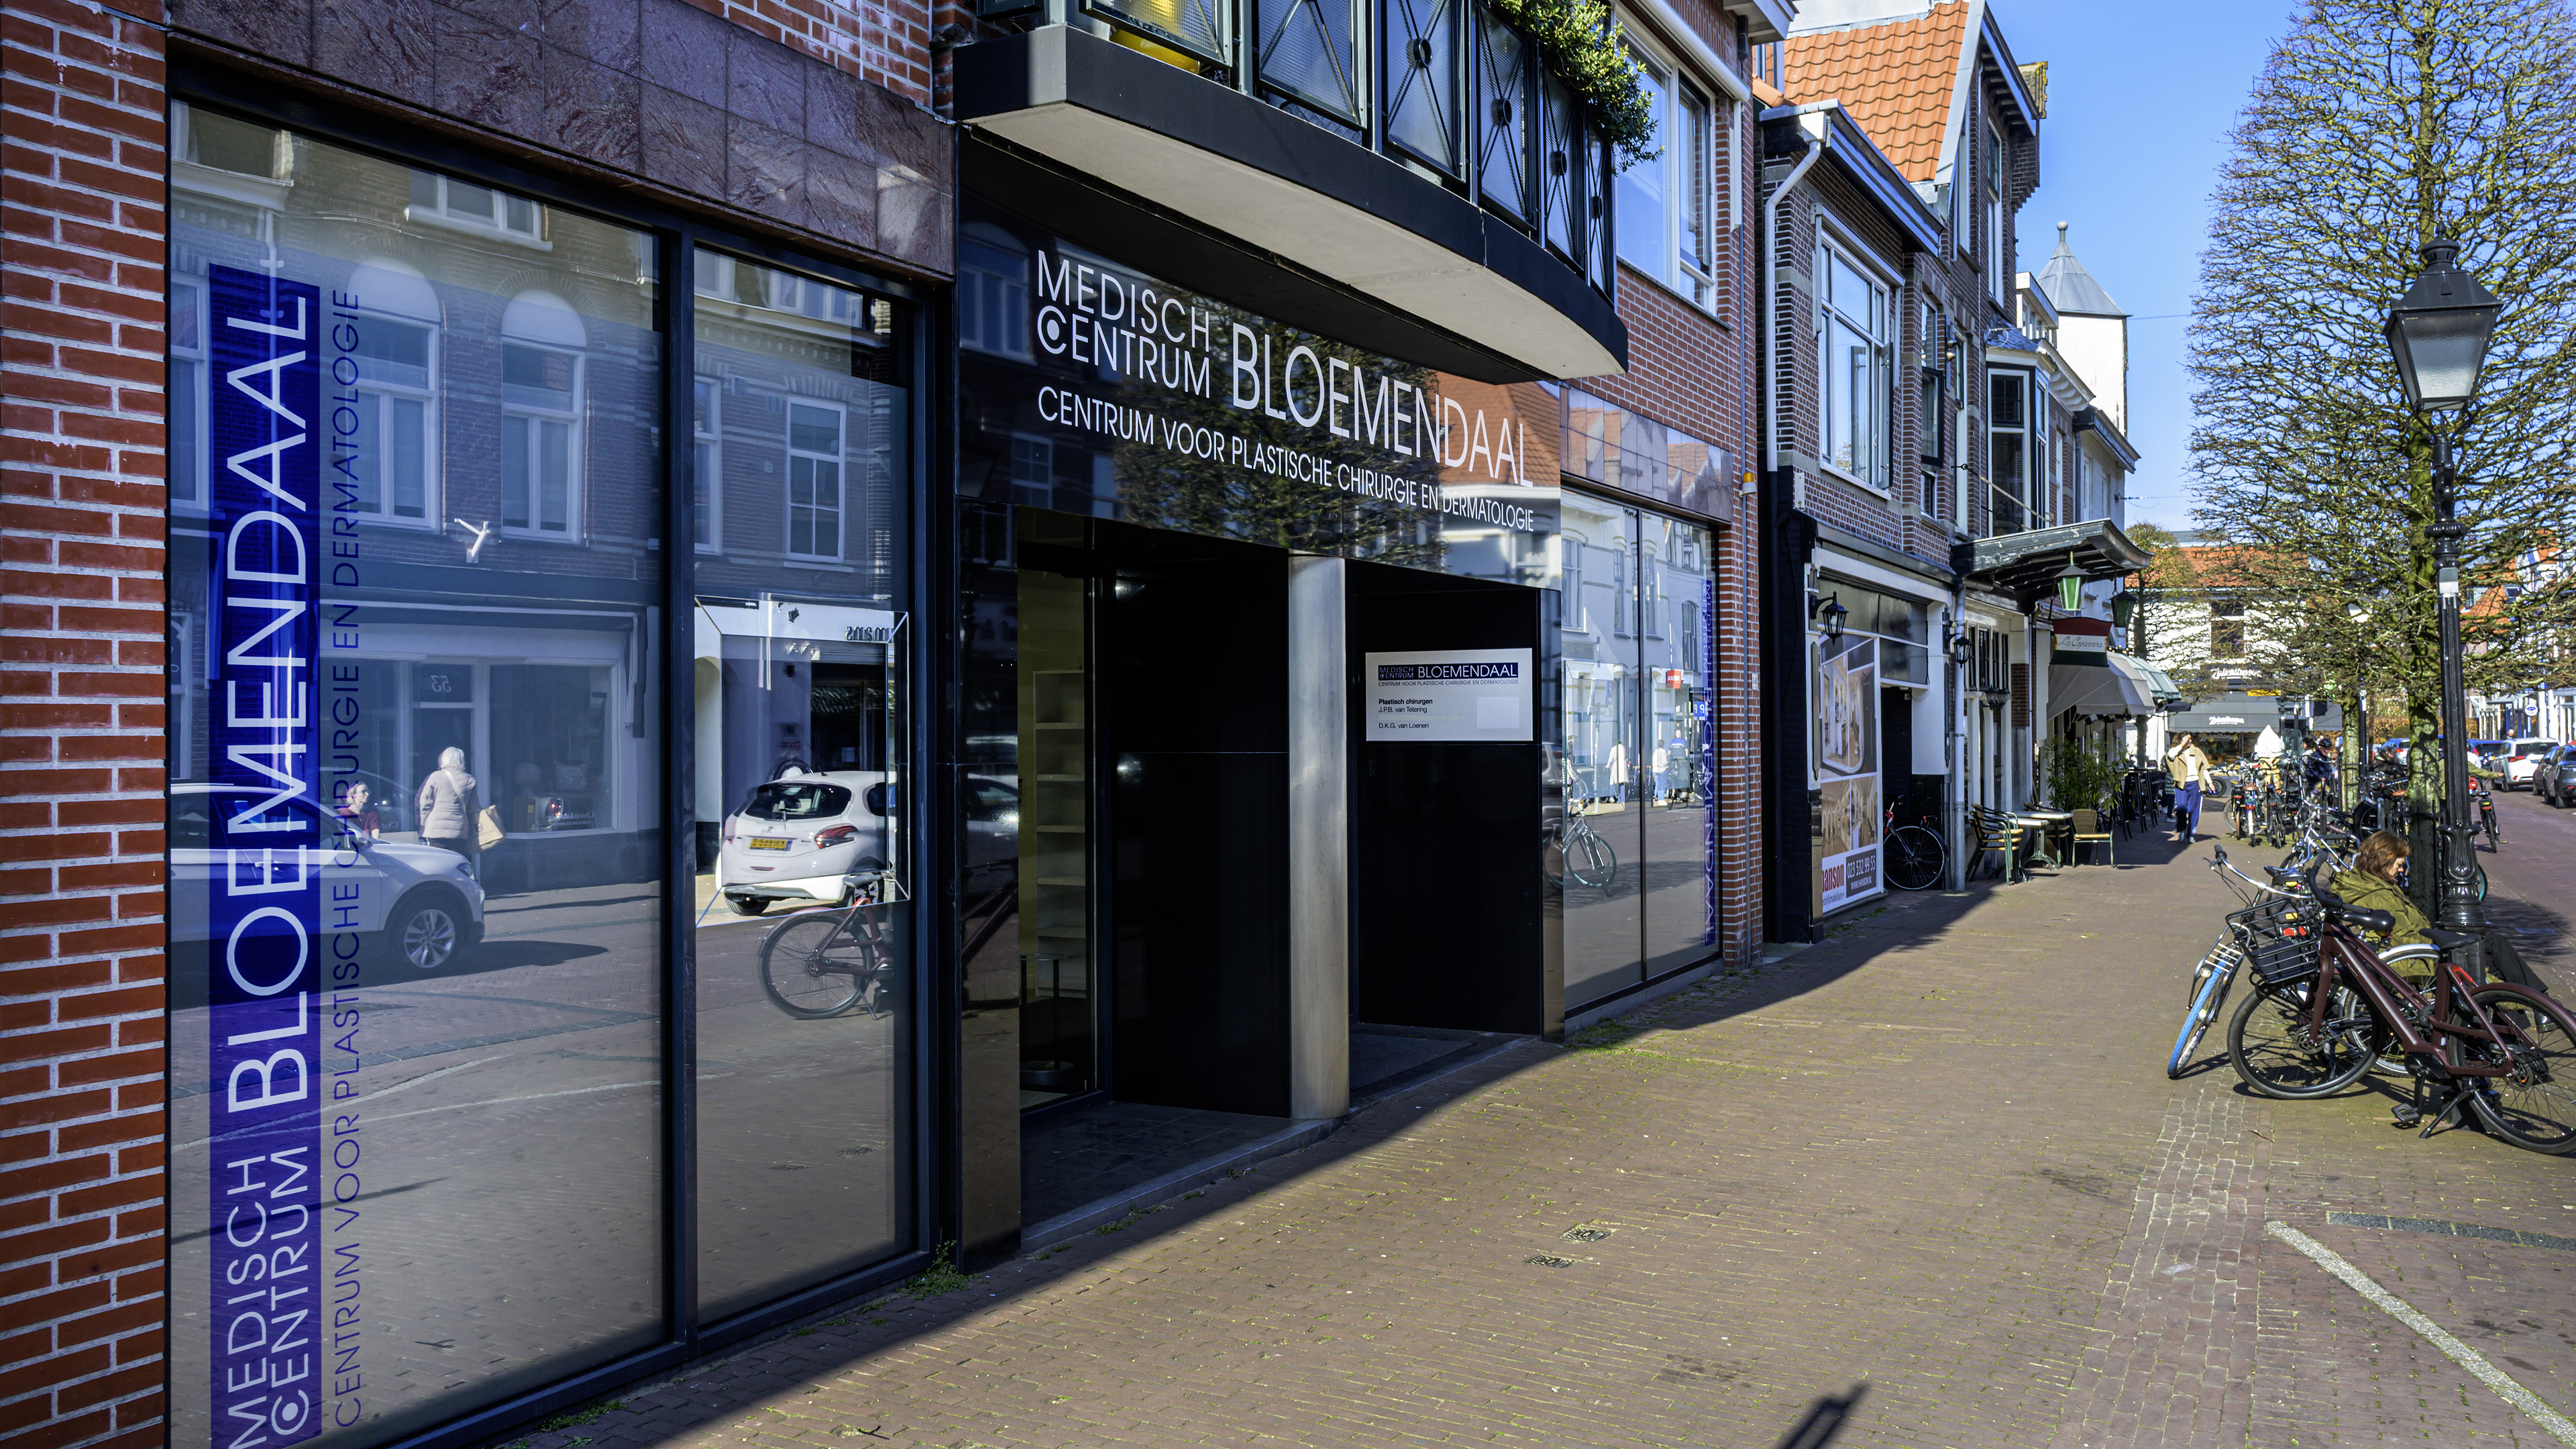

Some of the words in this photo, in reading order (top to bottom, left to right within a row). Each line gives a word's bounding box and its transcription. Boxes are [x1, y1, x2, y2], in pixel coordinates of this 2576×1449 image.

[1037, 250, 1210, 352] MEDISCH
[332, 289, 359, 587] DERMATOLOGIE
[1037, 306, 1210, 398] CENTRUM
[1233, 323, 1533, 488] BLOEMENDAAL
[1038, 386, 1155, 445] CENTRUM
[1162, 417, 1226, 464] VOOR
[1232, 437, 1332, 487] PLASTISCHE
[1338, 464, 1416, 506] CHIRURGIE
[1421, 485, 1439, 512] EN
[1442, 490, 1534, 532] DERMATOLOGIE
[227, 296, 309, 1113] BLOEMENDAAL
[333, 605, 358, 649] EN
[1418, 664, 1517, 678] BLOEMENDAAL
[2058, 635, 2071, 647] La
[333, 665, 360, 868] CHIRURGIE
[1847, 861, 1856, 879] 023
[1856, 859, 1864, 876] 532
[1864, 857, 1870, 873] 99
[1870, 855, 1876, 871] 55
[333, 883, 360, 1100] PLASTISCHE
[333, 1114, 360, 1232] VOOR
[227, 1155, 267, 1449] MEDISCH
[270, 1146, 309, 1435] CENTRUM
[334, 1242, 361, 1427] CENTRUM
